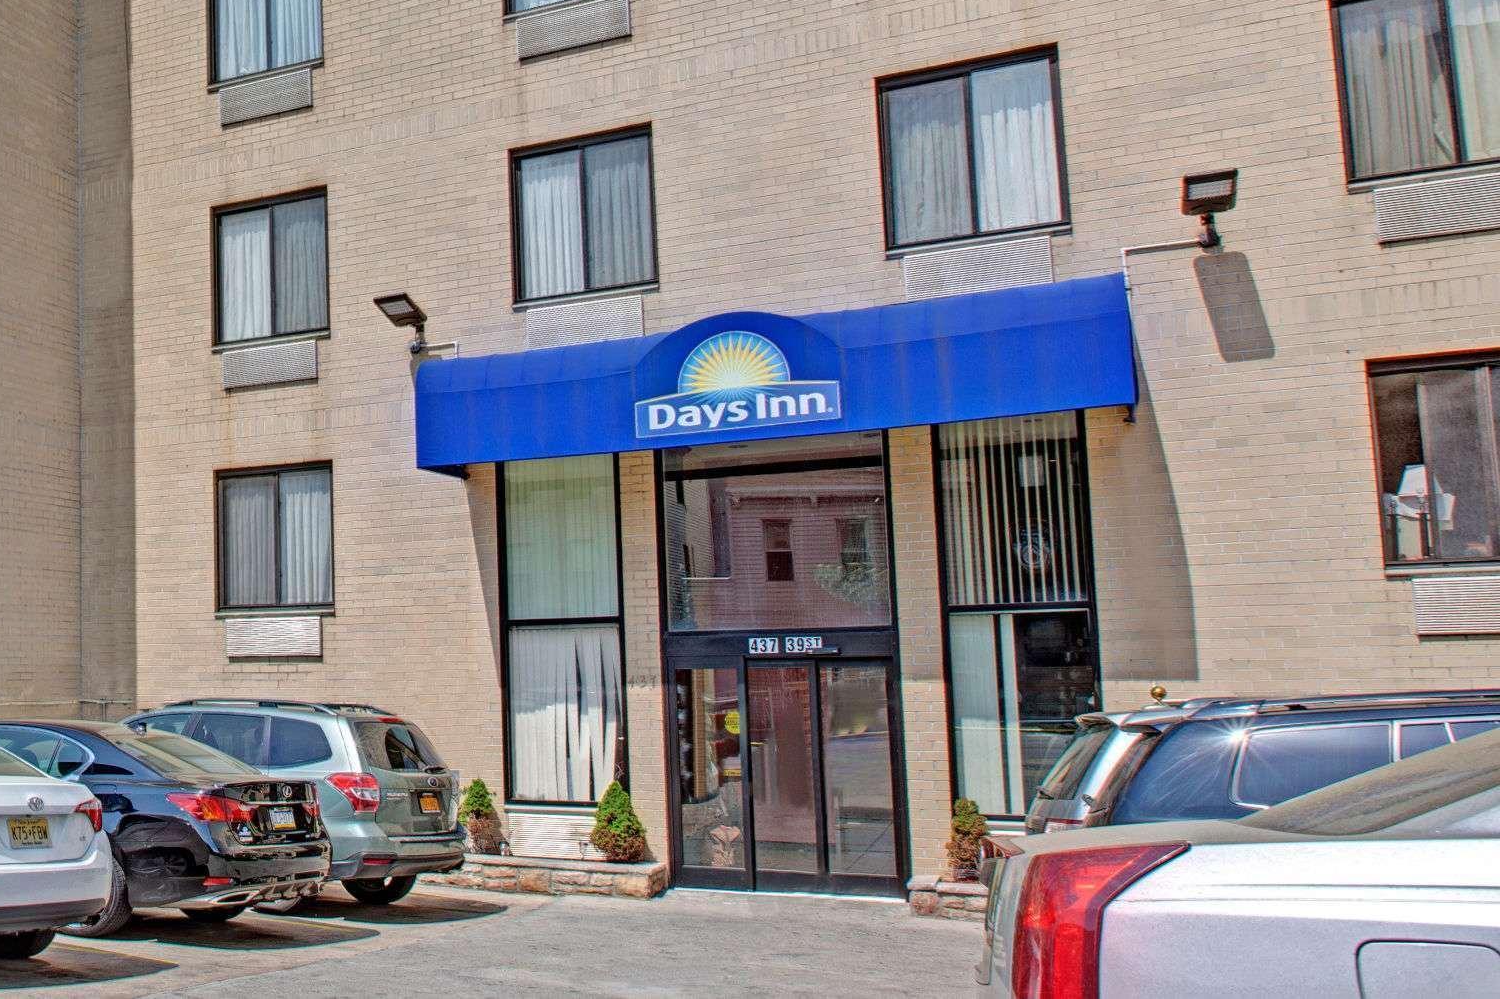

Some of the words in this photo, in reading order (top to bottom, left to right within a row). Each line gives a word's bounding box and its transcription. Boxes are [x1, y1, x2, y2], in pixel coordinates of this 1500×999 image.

[648, 400, 749, 431] Days
[755, 391, 828, 420] Inn
[749, 638, 778, 653] 437
